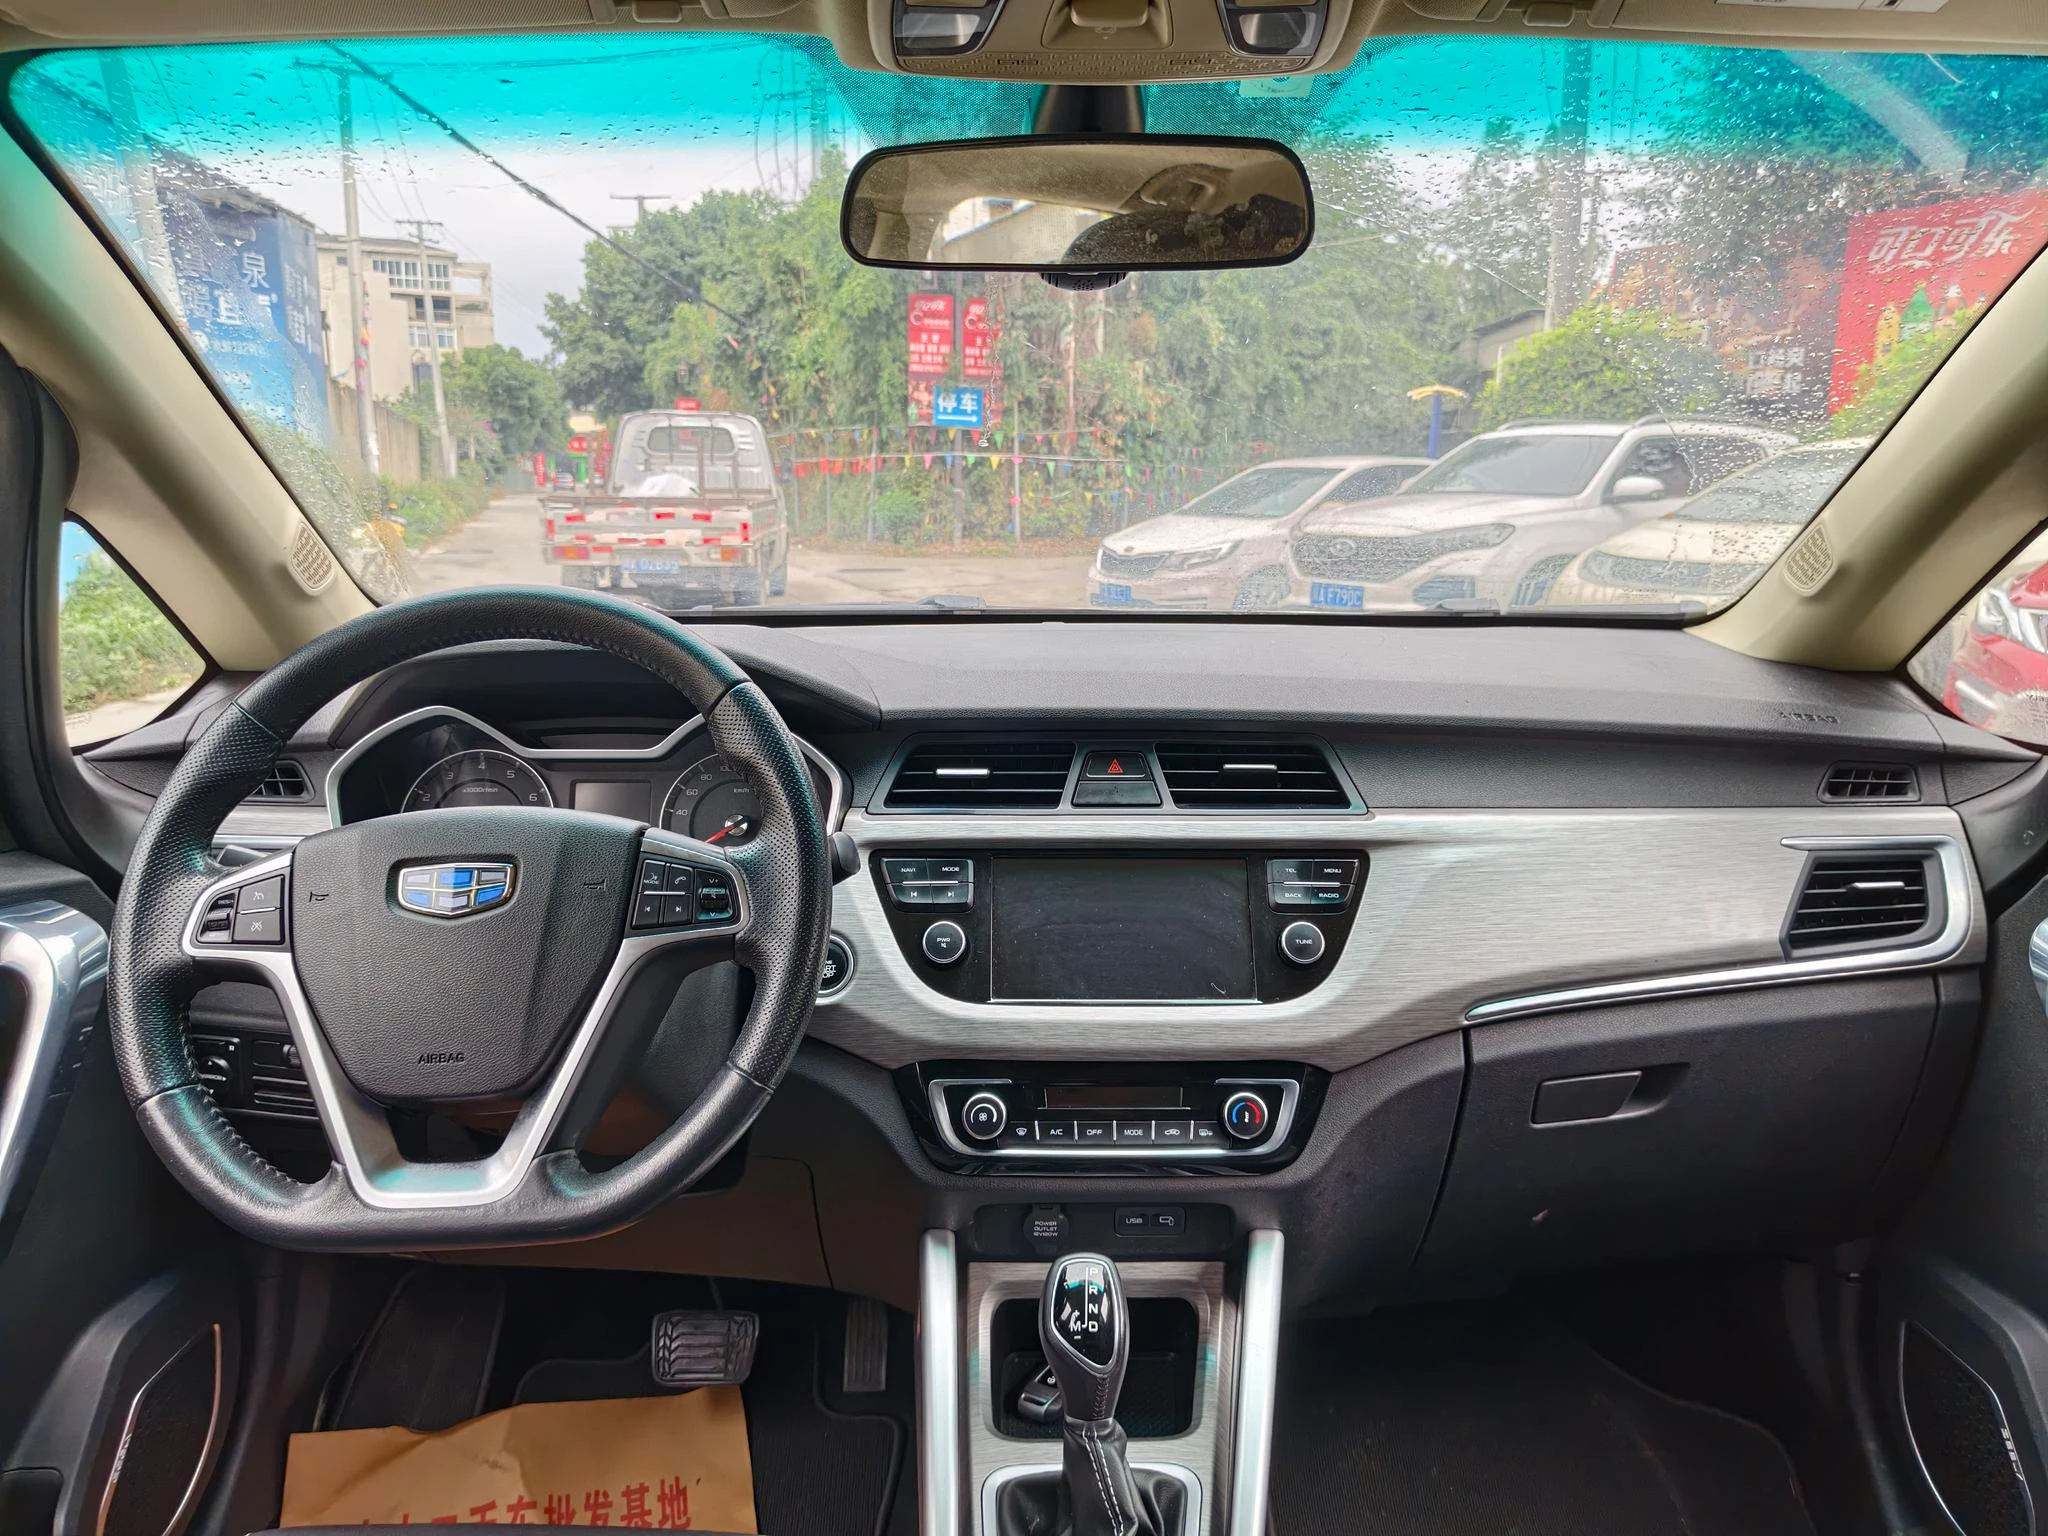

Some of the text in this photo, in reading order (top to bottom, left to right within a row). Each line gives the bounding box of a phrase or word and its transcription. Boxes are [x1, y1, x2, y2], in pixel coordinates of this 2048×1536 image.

[1868, 208, 2032, 275] 可口可乐
[938, 392, 978, 413] 停车
[478, 761, 486, 770] 4
[447, 771, 455, 780] 3
[506, 770, 516, 779] 5
[700, 773, 713, 781] 80
[686, 788, 699, 796] 60
[423, 793, 431, 802] 2
[529, 793, 538, 802] 6
[417, 1052, 466, 1065] AIRBAG
[1050, 1128, 1064, 1136] A/C
[1086, 1128, 1103, 1136] OFF
[1123, 1128, 1144, 1136] MODE
[1089, 1267, 1099, 1276] P
[1088, 1285, 1099, 1295] R
[1088, 1303, 1099, 1314] N
[1070, 1320, 1082, 1332] M
[1088, 1320, 1099, 1332] D
